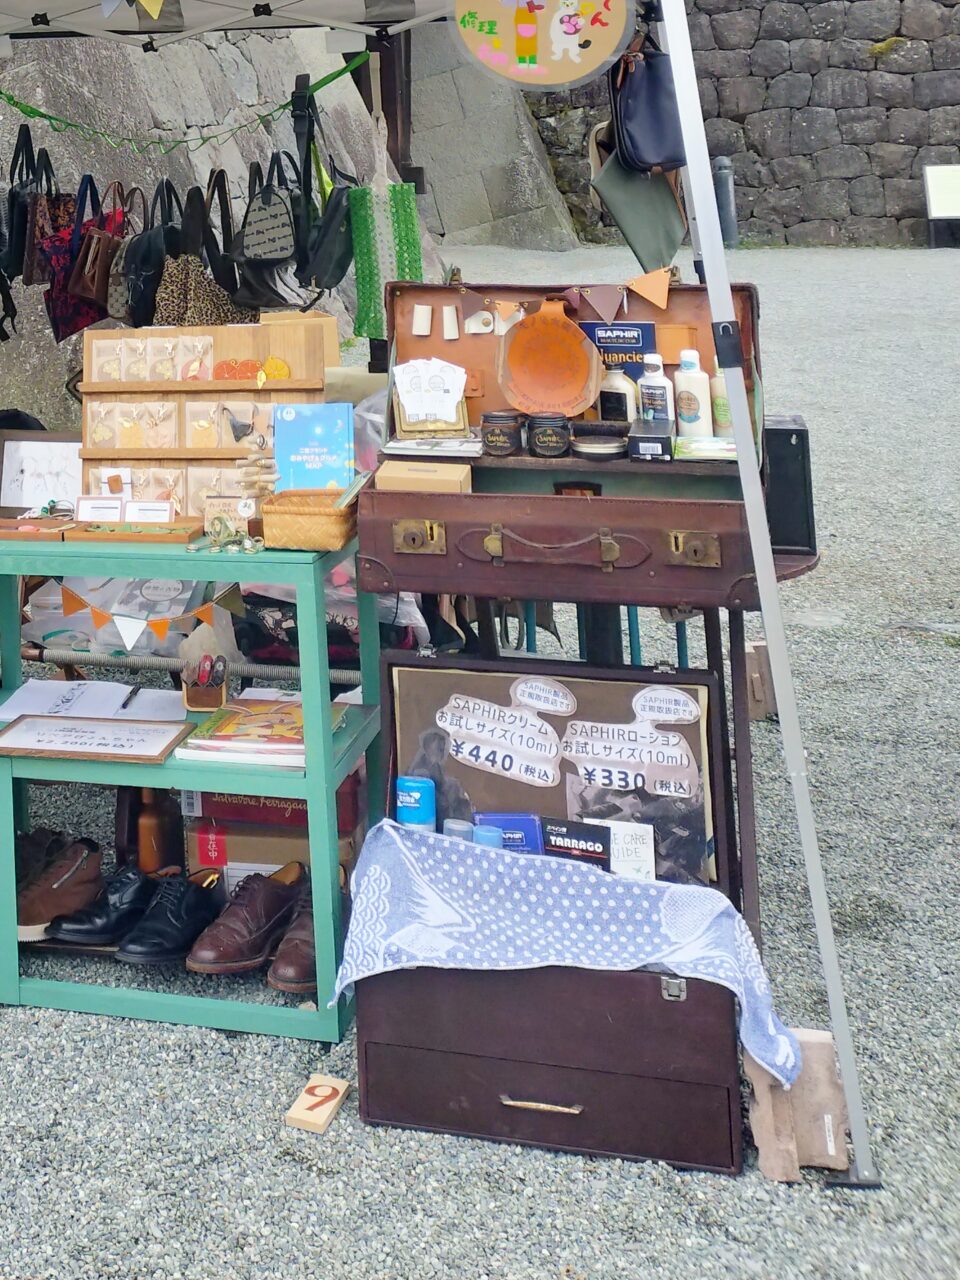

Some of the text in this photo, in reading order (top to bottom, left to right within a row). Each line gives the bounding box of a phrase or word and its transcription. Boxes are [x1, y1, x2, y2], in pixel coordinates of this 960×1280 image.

[597, 330, 639, 338] SAPHIR
[643, 695, 690, 708] SAPHIR製品
[453, 697, 548, 736] SAPHIRクリーム
[570, 722, 681, 747] SAPHIRローション
[451, 738, 514, 772] ¥440
[549, 835, 604, 853] TARRAGO
[624, 833, 649, 846] CARE
[304, 1084, 340, 1112] 9
